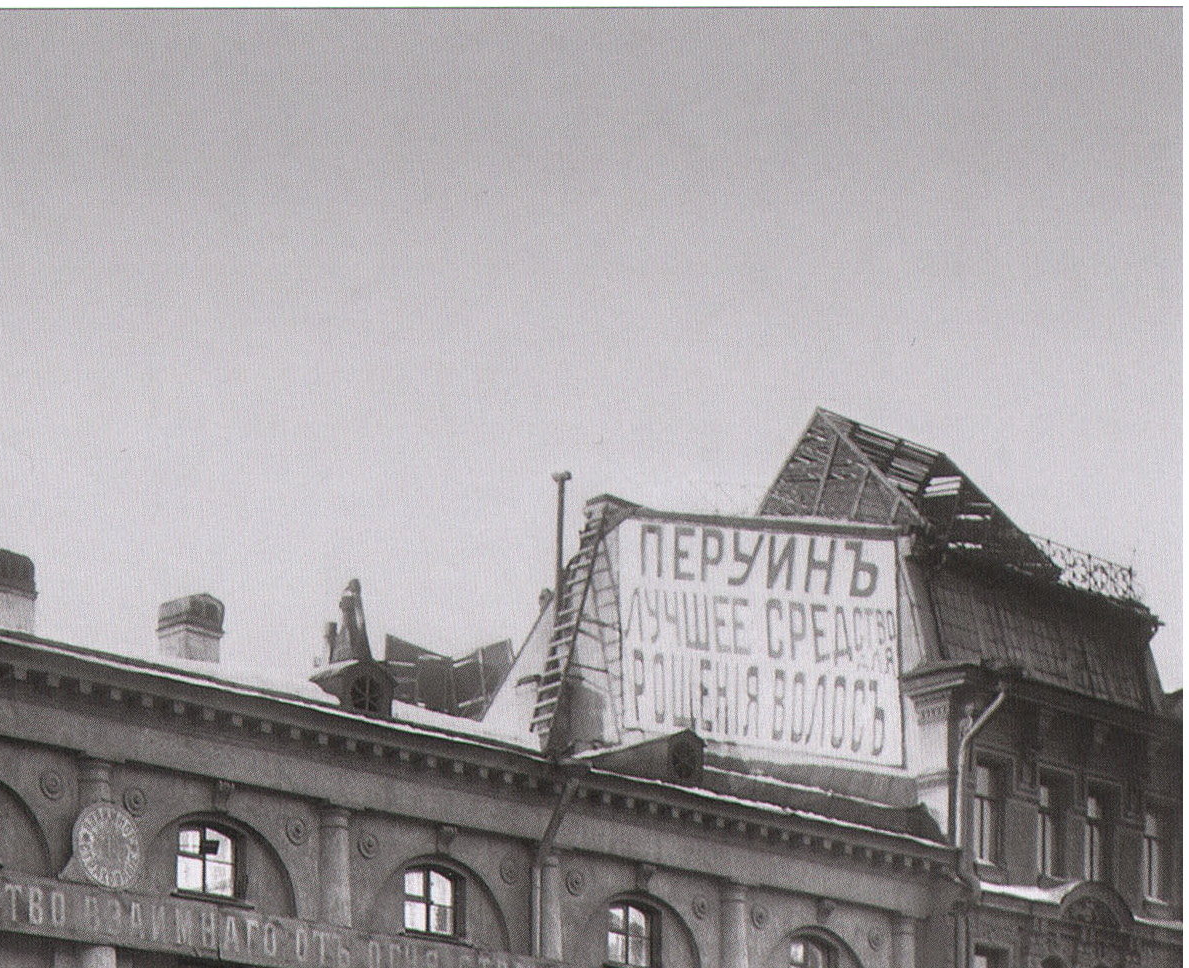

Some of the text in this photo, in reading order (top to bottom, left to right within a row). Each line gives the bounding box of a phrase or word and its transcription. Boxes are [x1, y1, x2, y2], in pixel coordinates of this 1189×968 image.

[641, 523, 879, 597] ПЕРУИНЪ
[623, 587, 896, 664] ЛУЧШЕЕ СРЕДСТВО
[771, 667, 884, 756] ВОЛОСЪ
[295, 927, 350, 968] ОТЪ
